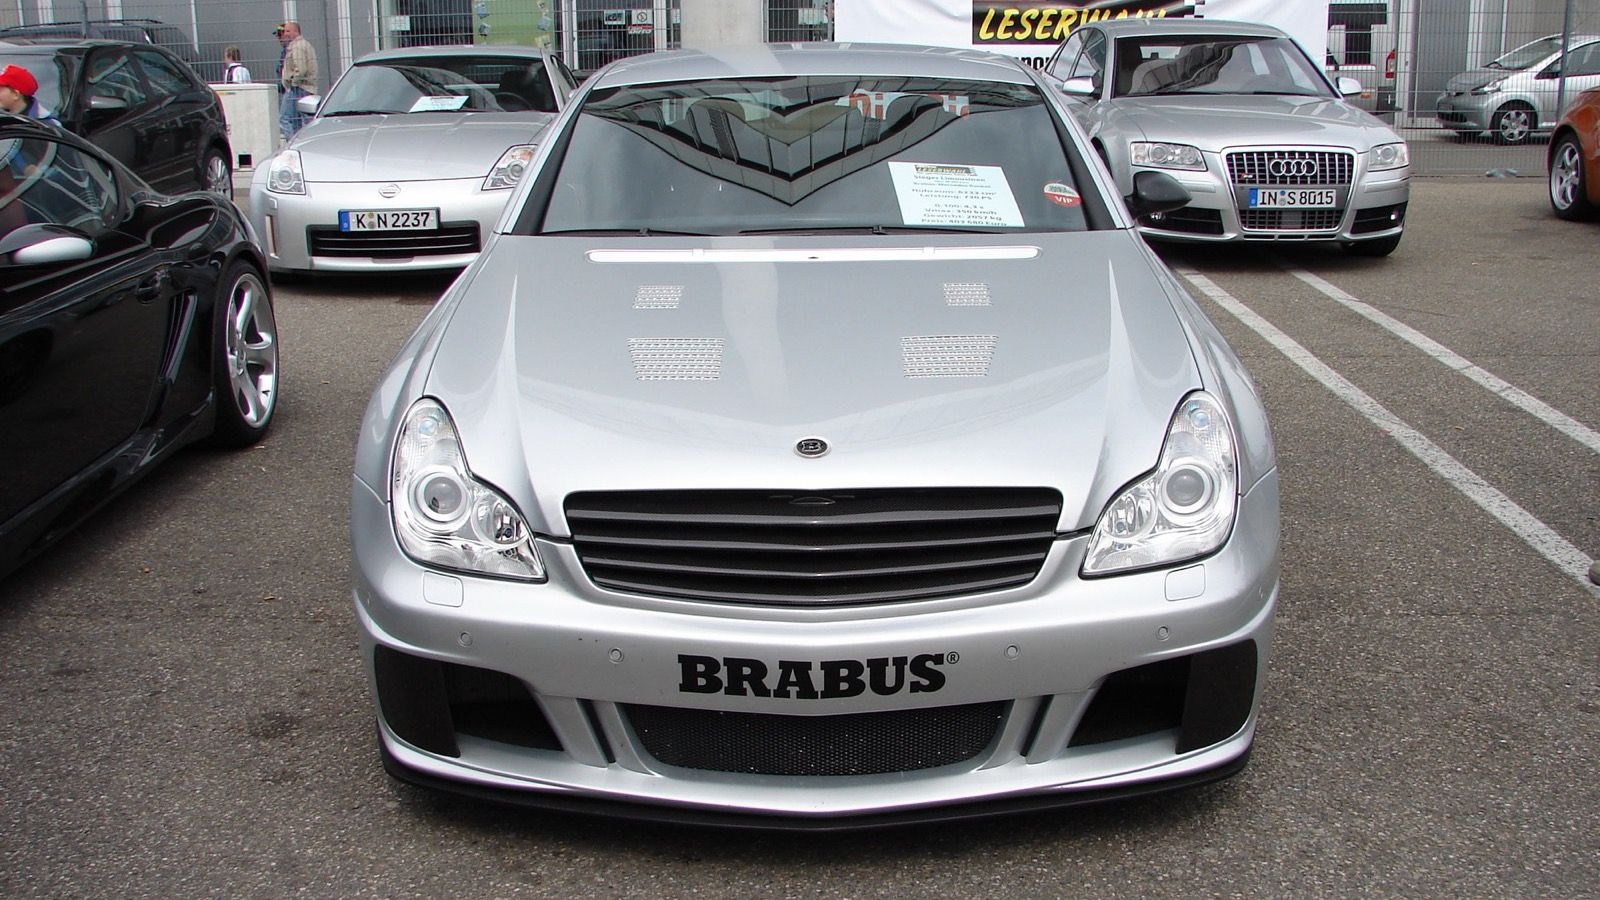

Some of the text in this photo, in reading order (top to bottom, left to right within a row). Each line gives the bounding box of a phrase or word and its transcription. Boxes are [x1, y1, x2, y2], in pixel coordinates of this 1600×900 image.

[1055, 195, 1073, 204] VIP
[1260, 191, 1334, 205] IN S 8015
[356, 212, 430, 229] K N 2237
